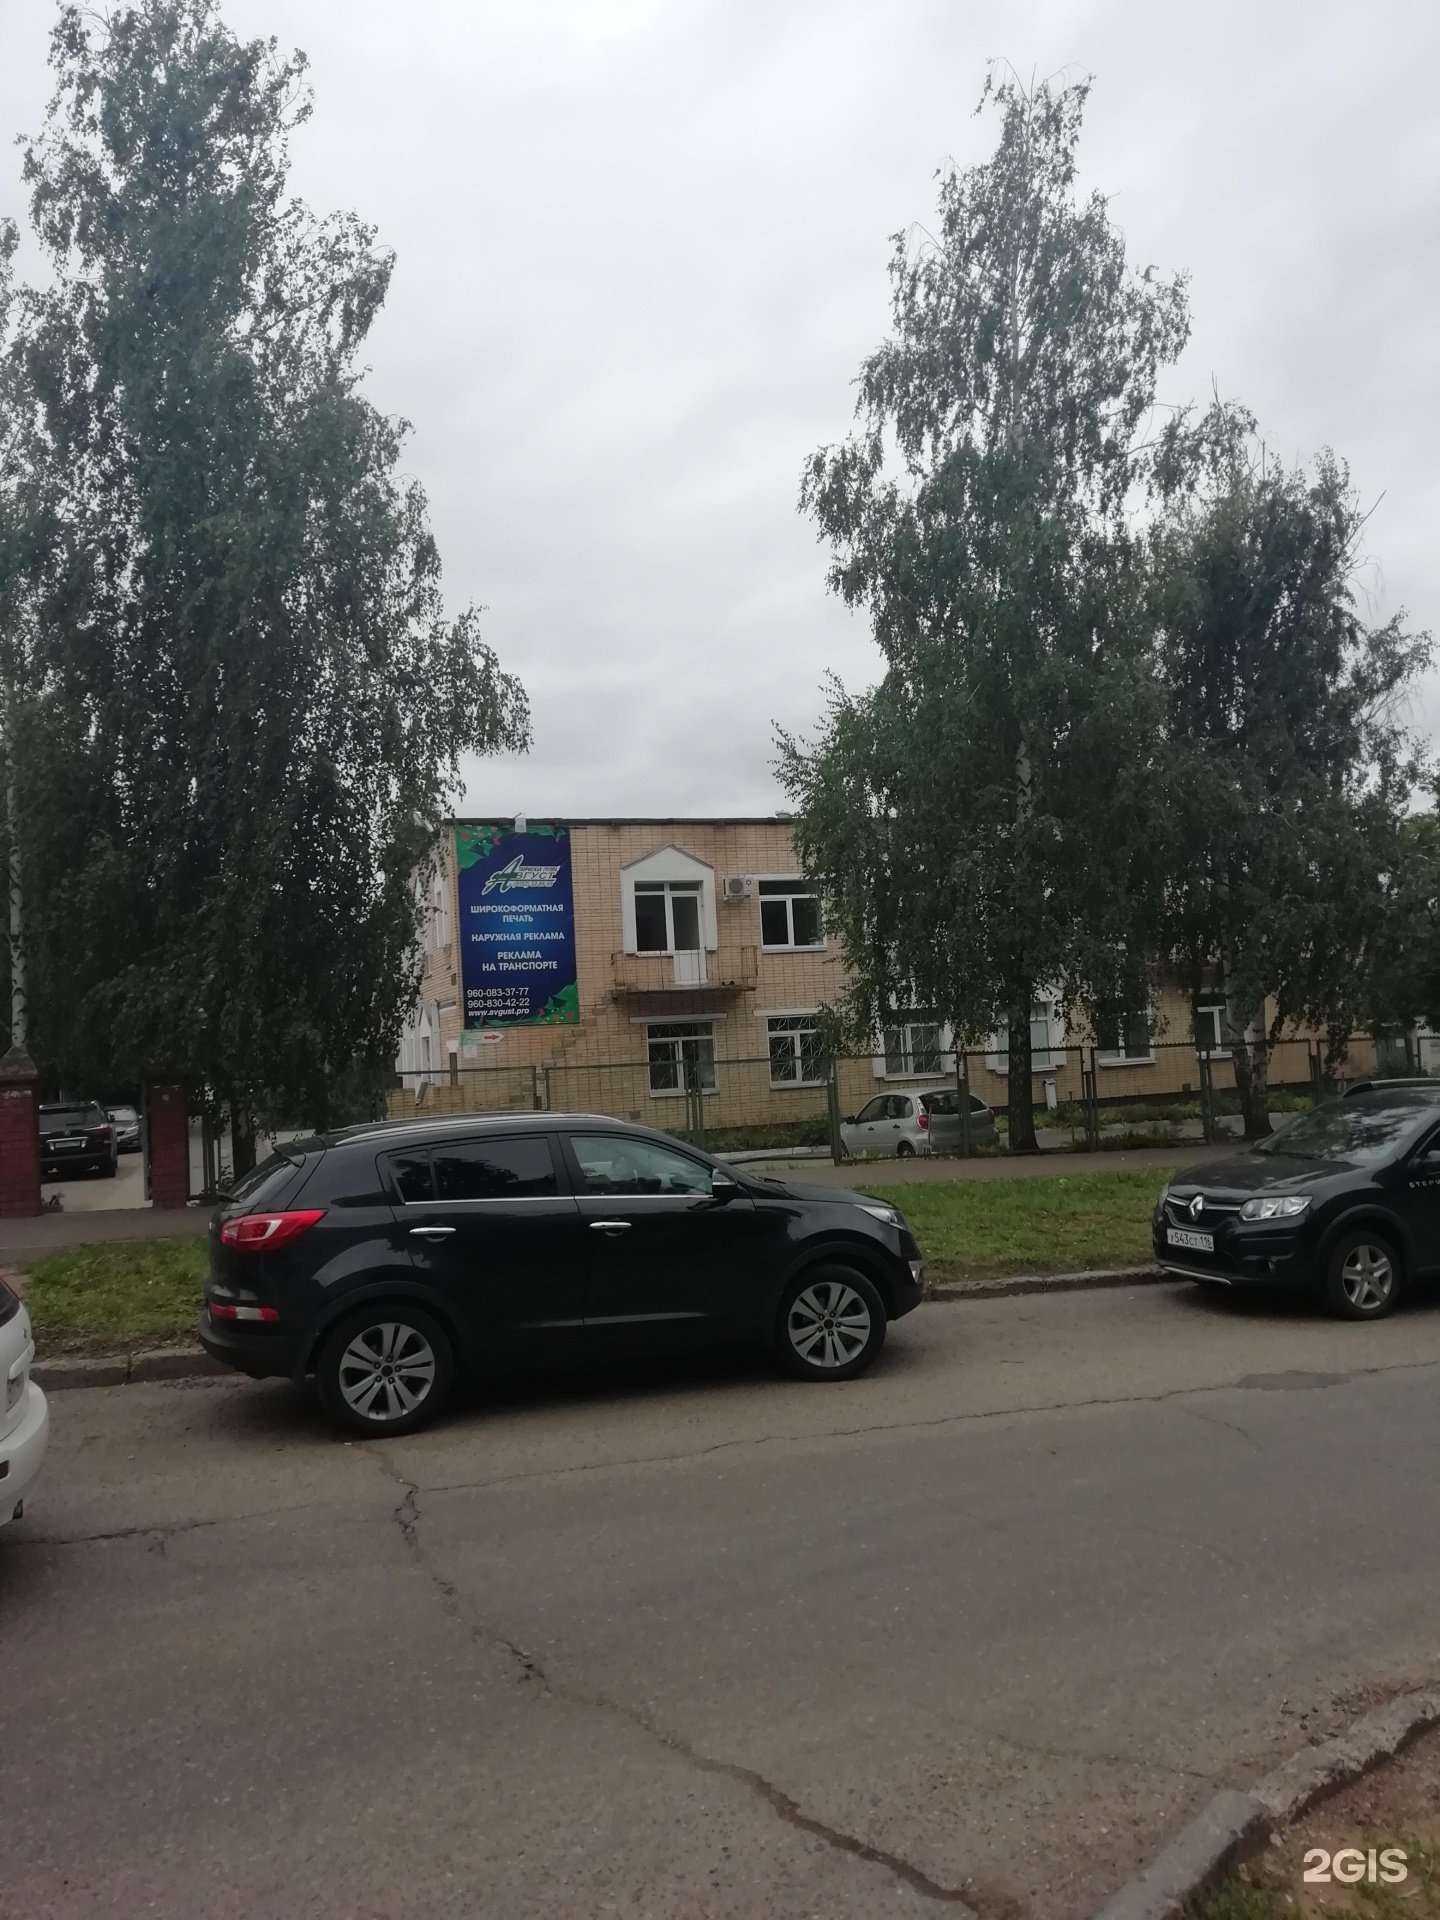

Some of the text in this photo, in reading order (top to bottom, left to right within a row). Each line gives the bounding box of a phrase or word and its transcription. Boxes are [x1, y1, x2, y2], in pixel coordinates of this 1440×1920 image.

[470, 904, 564, 914] ШИРОКОФОРМАТНАЯ
[502, 914, 534, 923] ПЕЧАТЬ
[471, 932, 565, 942] НАРУЖНАЯ РЕКЛАМА
[497, 951, 542, 960] РЕКЛАМА
[482, 961, 558, 972] НА ТРАНСПОРТЕ
[466, 987, 529, 998] 960-083-37-77
[467, 998, 530, 1009] 960-830-42-22
[468, 1008, 530, 1017] www.avgust.pro
